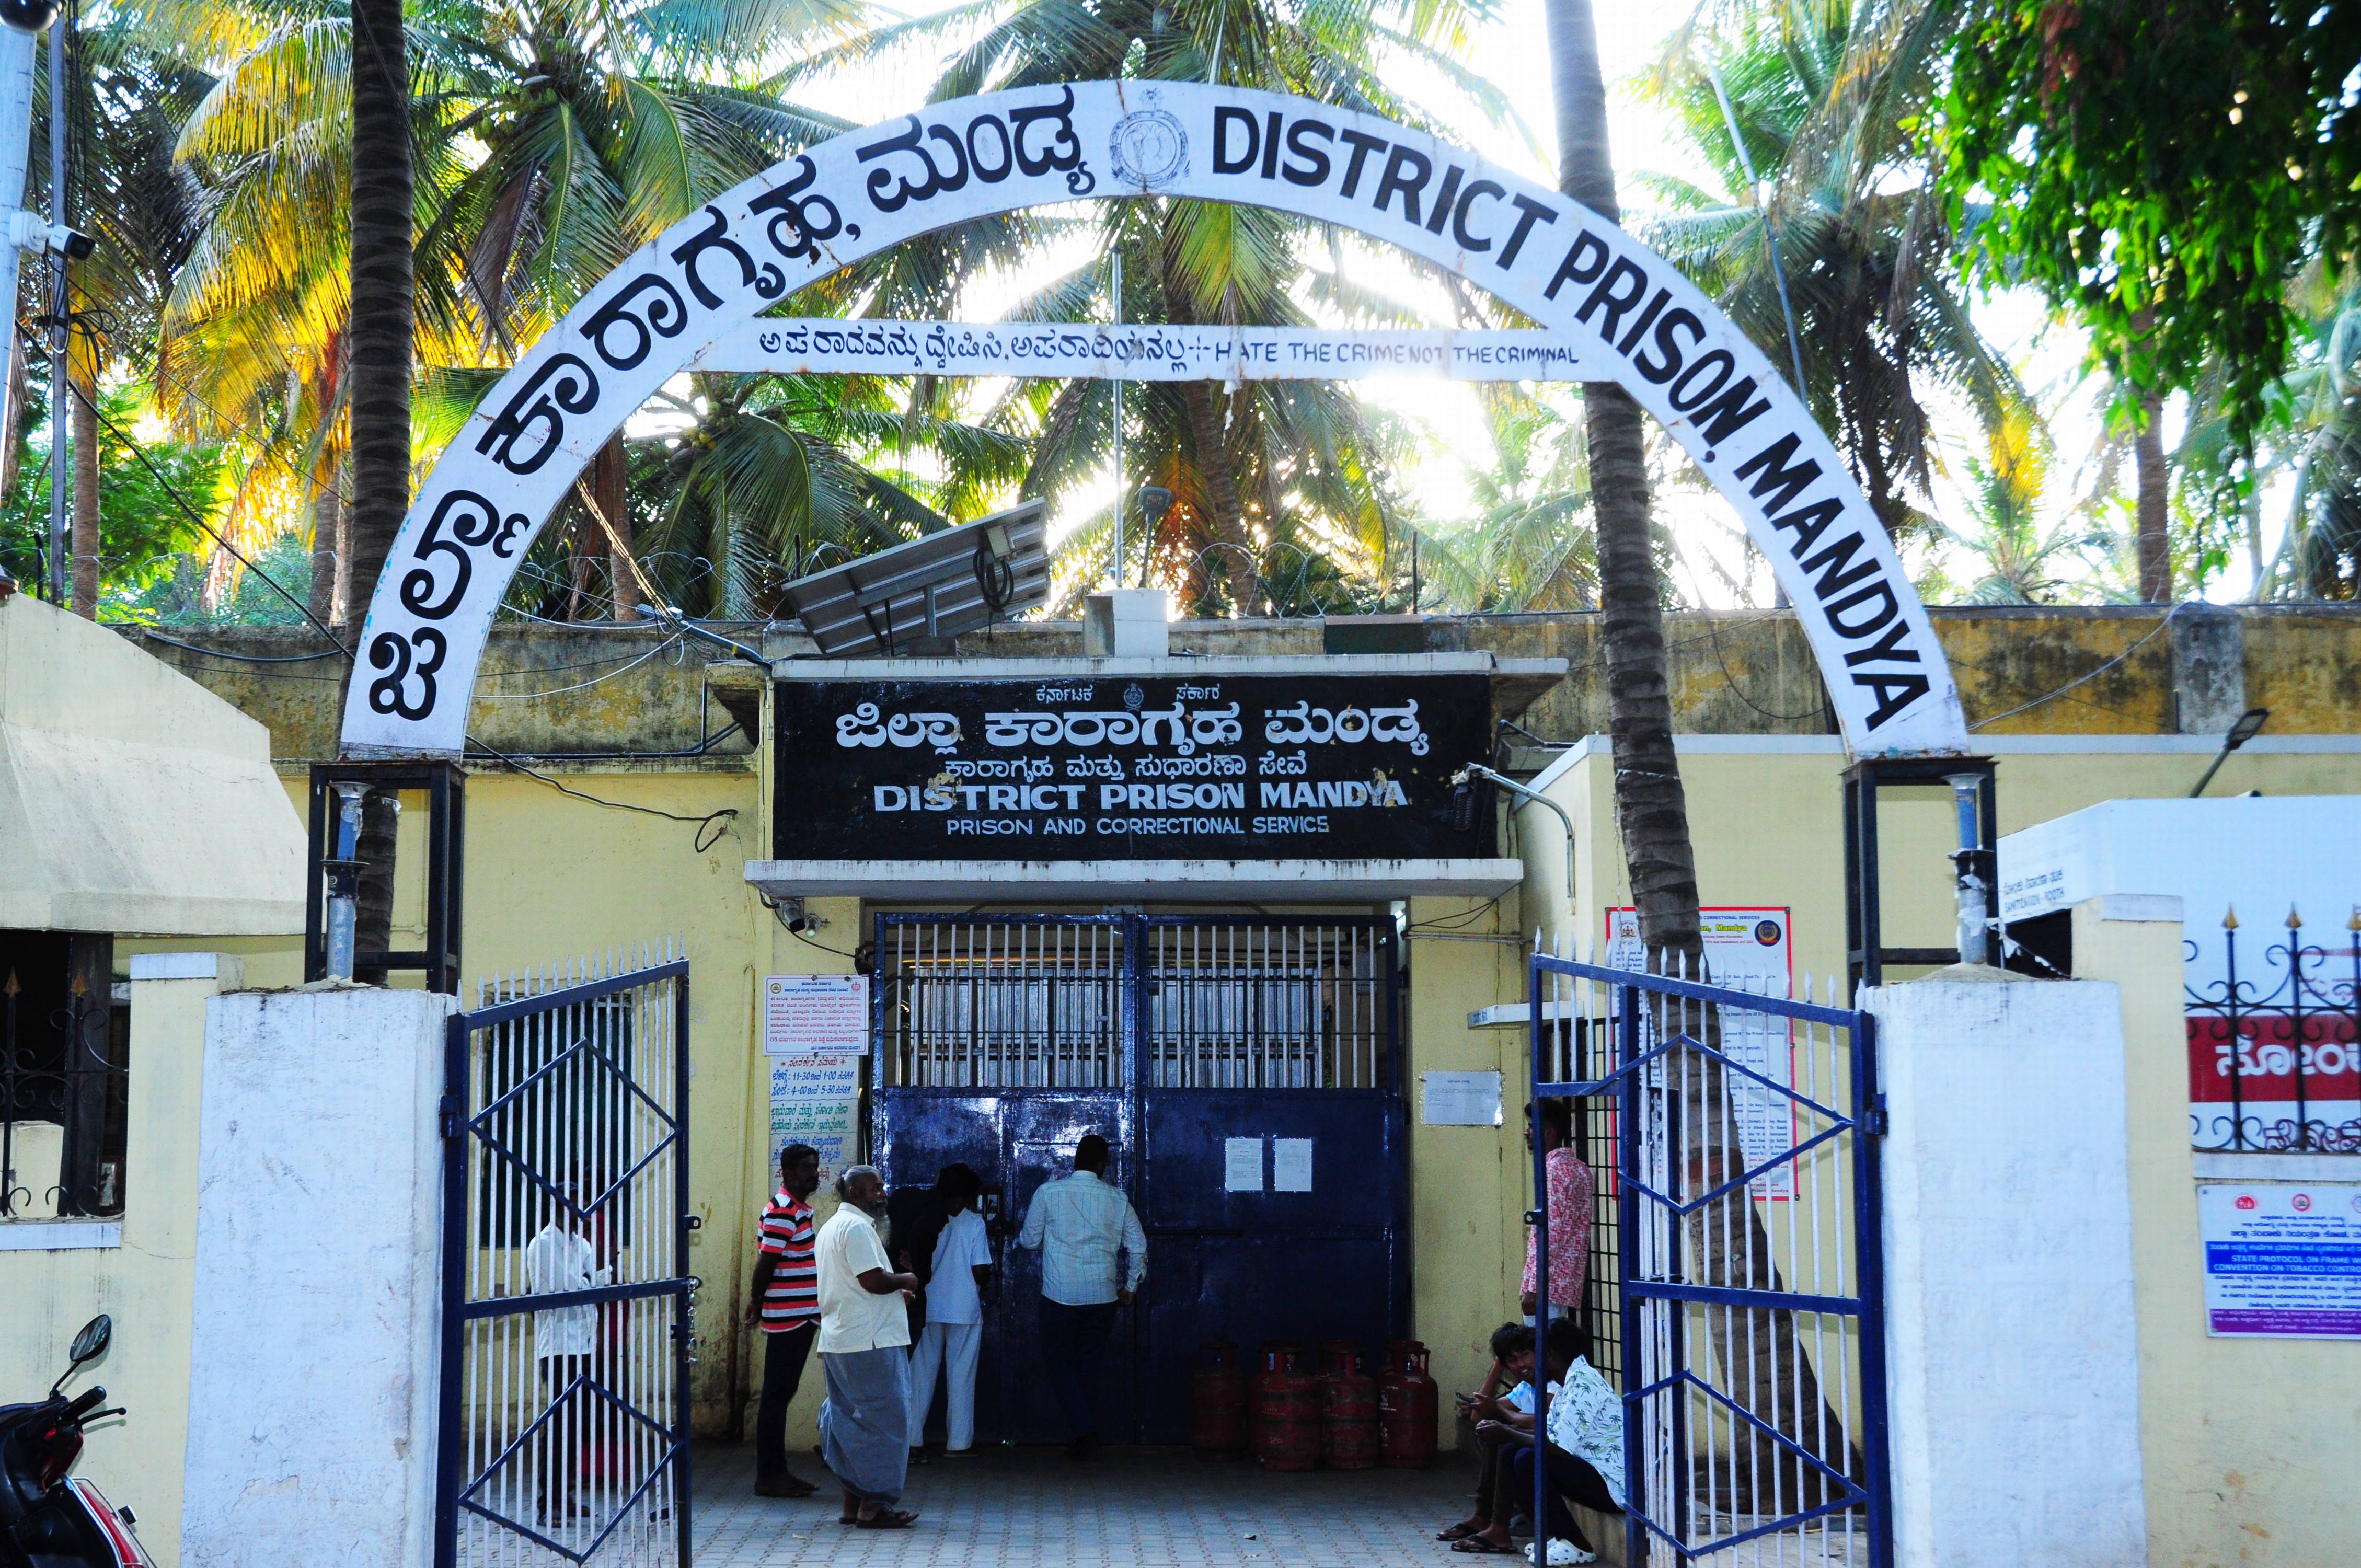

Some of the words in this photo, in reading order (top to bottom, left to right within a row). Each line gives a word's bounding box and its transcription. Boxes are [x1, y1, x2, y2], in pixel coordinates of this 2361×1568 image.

[1216, 341, 1277, 363] HATE
[1287, 342, 1331, 363] THE
[1336, 343, 1405, 364] CRIME
[1408, 344, 1443, 364] NOT
[1453, 346, 1492, 364] THE
[1496, 346, 1580, 365] CRIMINAL
[369, 490, 529, 720] ಜಿಲ್ಲಾ
[856, 85, 1095, 212] ಮಂಡ್ಯ
[1213, 106, 1558, 271] DISTRICT
[1545, 228, 1771, 464] PRISON,
[1735, 432, 1931, 731] MANDYA
[1036, 684, 1093, 704] ಕರ್ನಾಟಕ
[1176, 683, 1220, 701] ಸರ್ಕಾರ
[836, 702, 962, 755] ಜಿಲ್ಲಾ
[985, 701, 1242, 755] ಕಾರಾಗೃಹ
[1264, 698, 1430, 756] ಮಂಡ್ಯ
[945, 756, 1054, 783] ಕಾರಾಗೃಹ
[1066, 754, 1125, 780] ಮತ್ತು
[1258, 751, 1307, 775] ಸೇವೆ
[873, 784, 1086, 811] DISTRICT
[1100, 783, 1245, 810] PRISON
[1260, 780, 1408, 809] MANDYA
[947, 818, 1033, 835] PRISON
[1043, 818, 1086, 835] AND
[1097, 816, 1245, 835] CORRECTIONAL
[1252, 815, 1329, 833] SERVICE
[1715, 923, 1747, 933] Mandya
